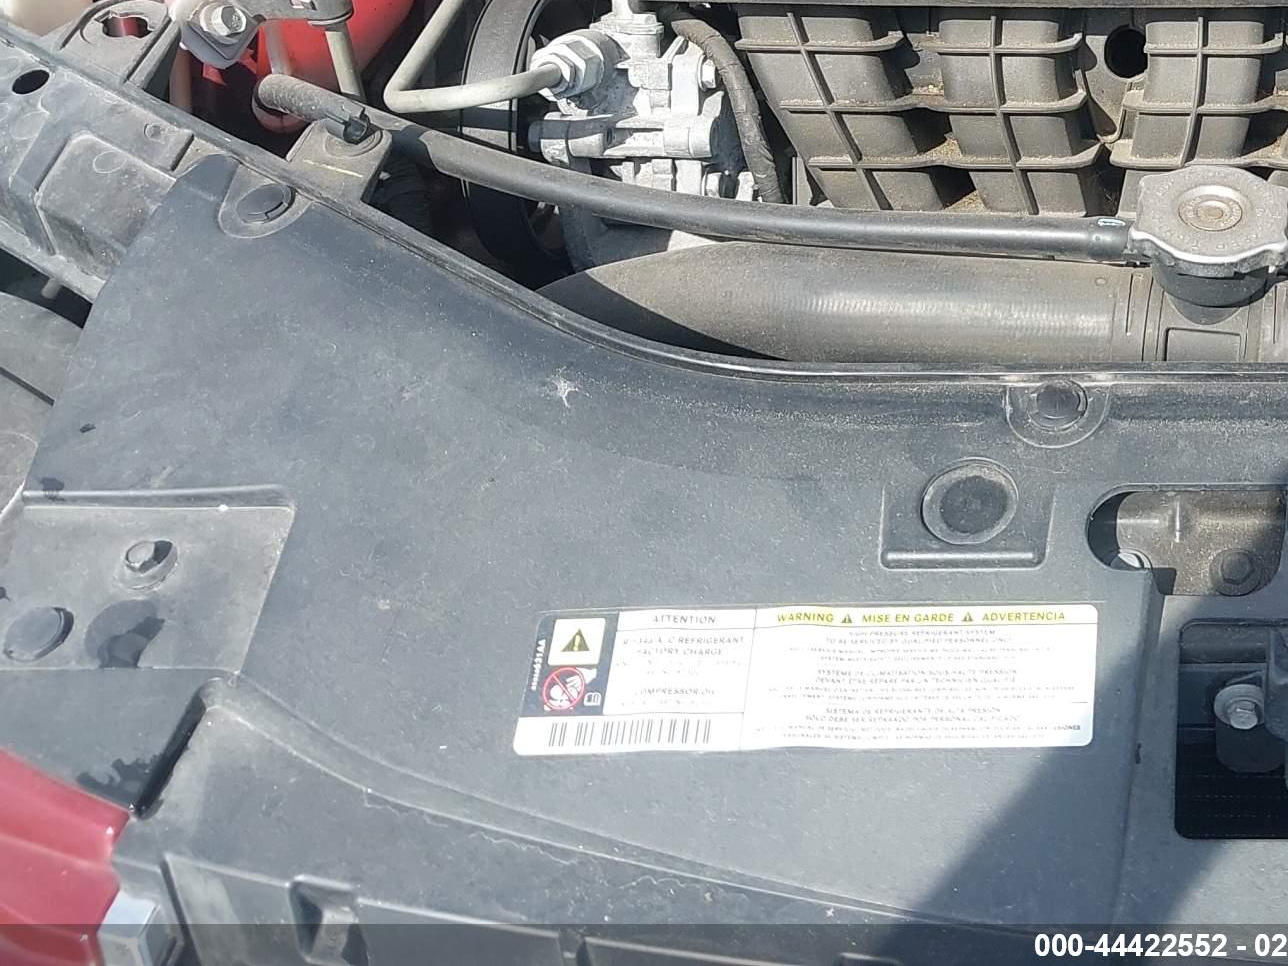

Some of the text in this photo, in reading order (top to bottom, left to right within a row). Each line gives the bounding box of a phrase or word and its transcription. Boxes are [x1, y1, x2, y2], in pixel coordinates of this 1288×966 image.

[653, 614, 716, 624] ATTENTION
[777, 611, 1066, 623] WARNING MISE EN GARDE ADVERTENCIA
